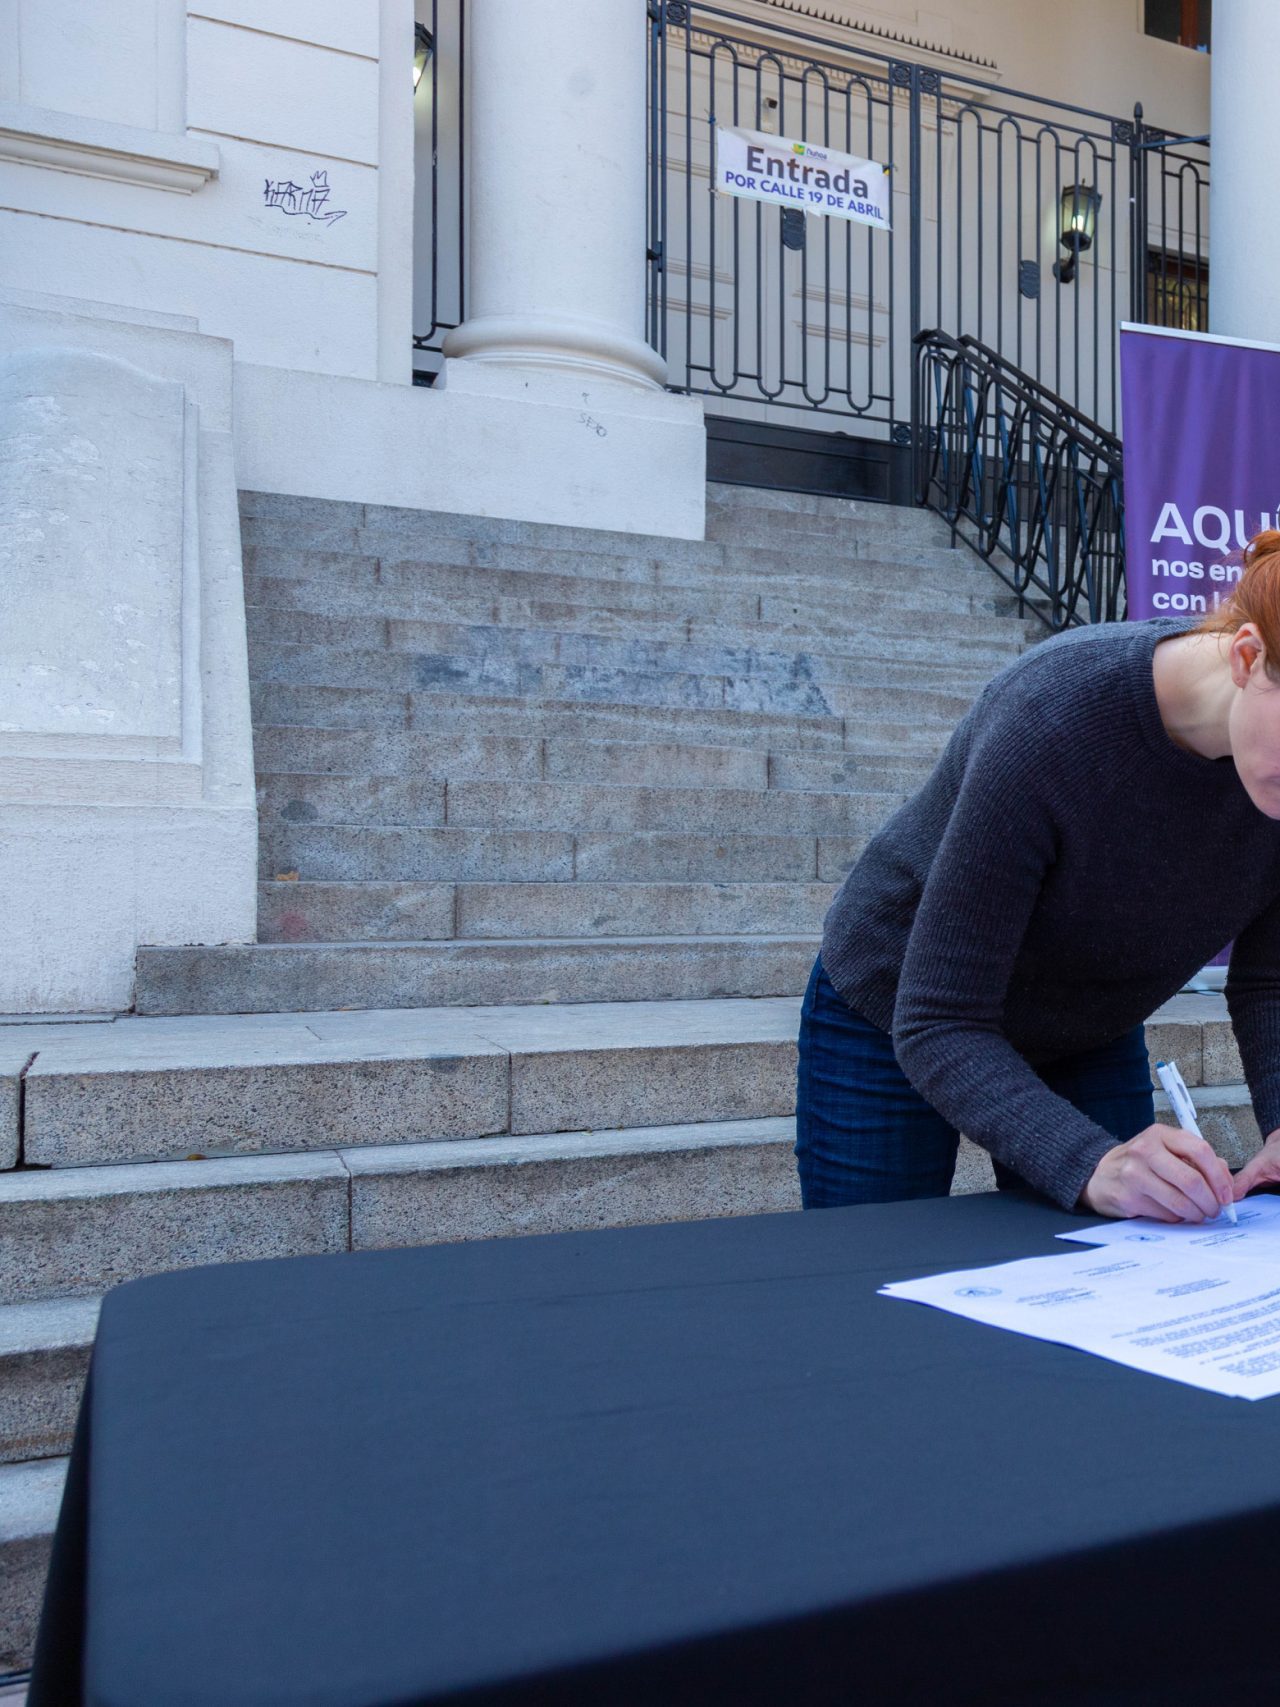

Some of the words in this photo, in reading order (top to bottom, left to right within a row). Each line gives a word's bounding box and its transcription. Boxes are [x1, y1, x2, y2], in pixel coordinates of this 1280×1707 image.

[725, 171, 756, 190] POR
[760, 179, 805, 200] CALLE
[808, 190, 823, 204] 19
[827, 194, 844, 209] DE
[847, 199, 884, 220] ABRIL
[746, 145, 869, 199] Entrada
[1150, 502, 1280, 556] AQU
[1152, 558, 1205, 579] nos
[1152, 591, 1206, 612] con
